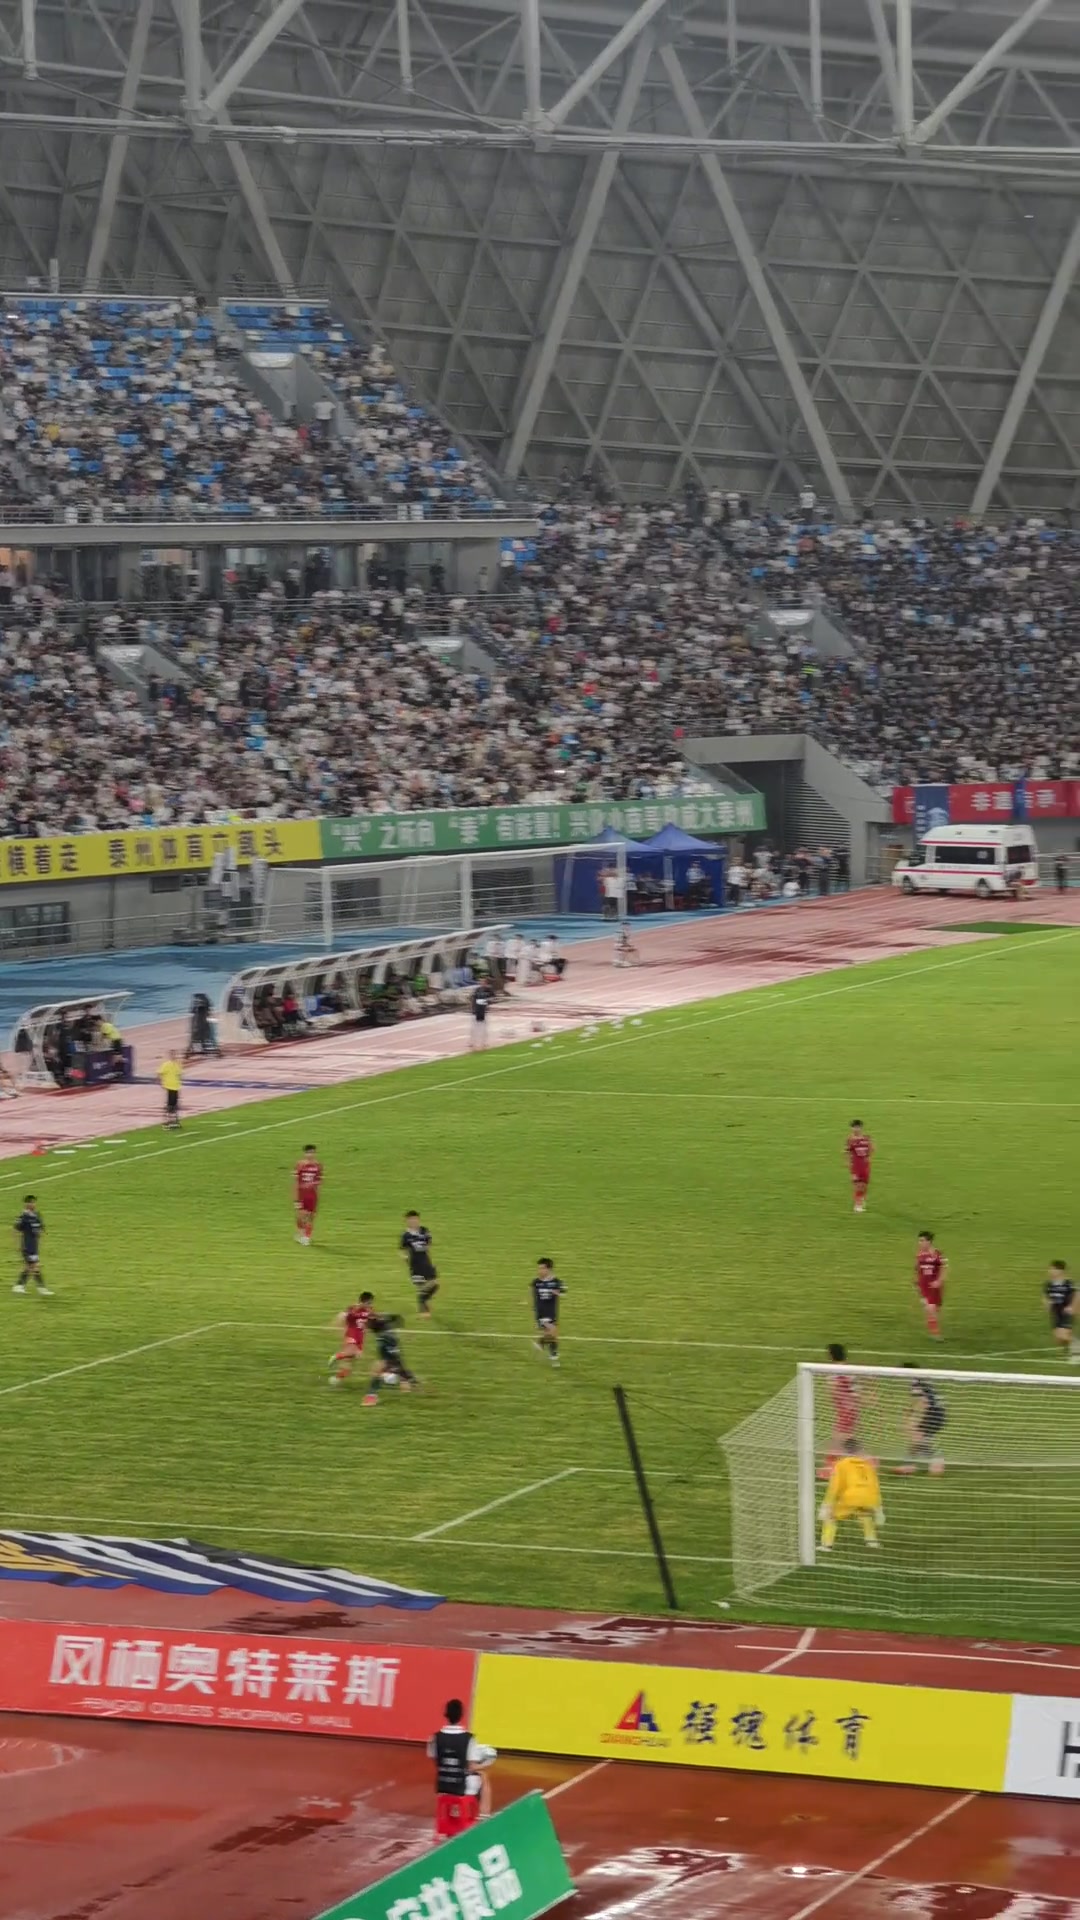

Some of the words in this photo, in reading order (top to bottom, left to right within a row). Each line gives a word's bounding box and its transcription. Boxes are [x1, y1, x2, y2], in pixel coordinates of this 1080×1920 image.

[48, 1634, 401, 1708] 凤栖奥特莱斯
[218, 1706, 303, 1724] SHOPPING
